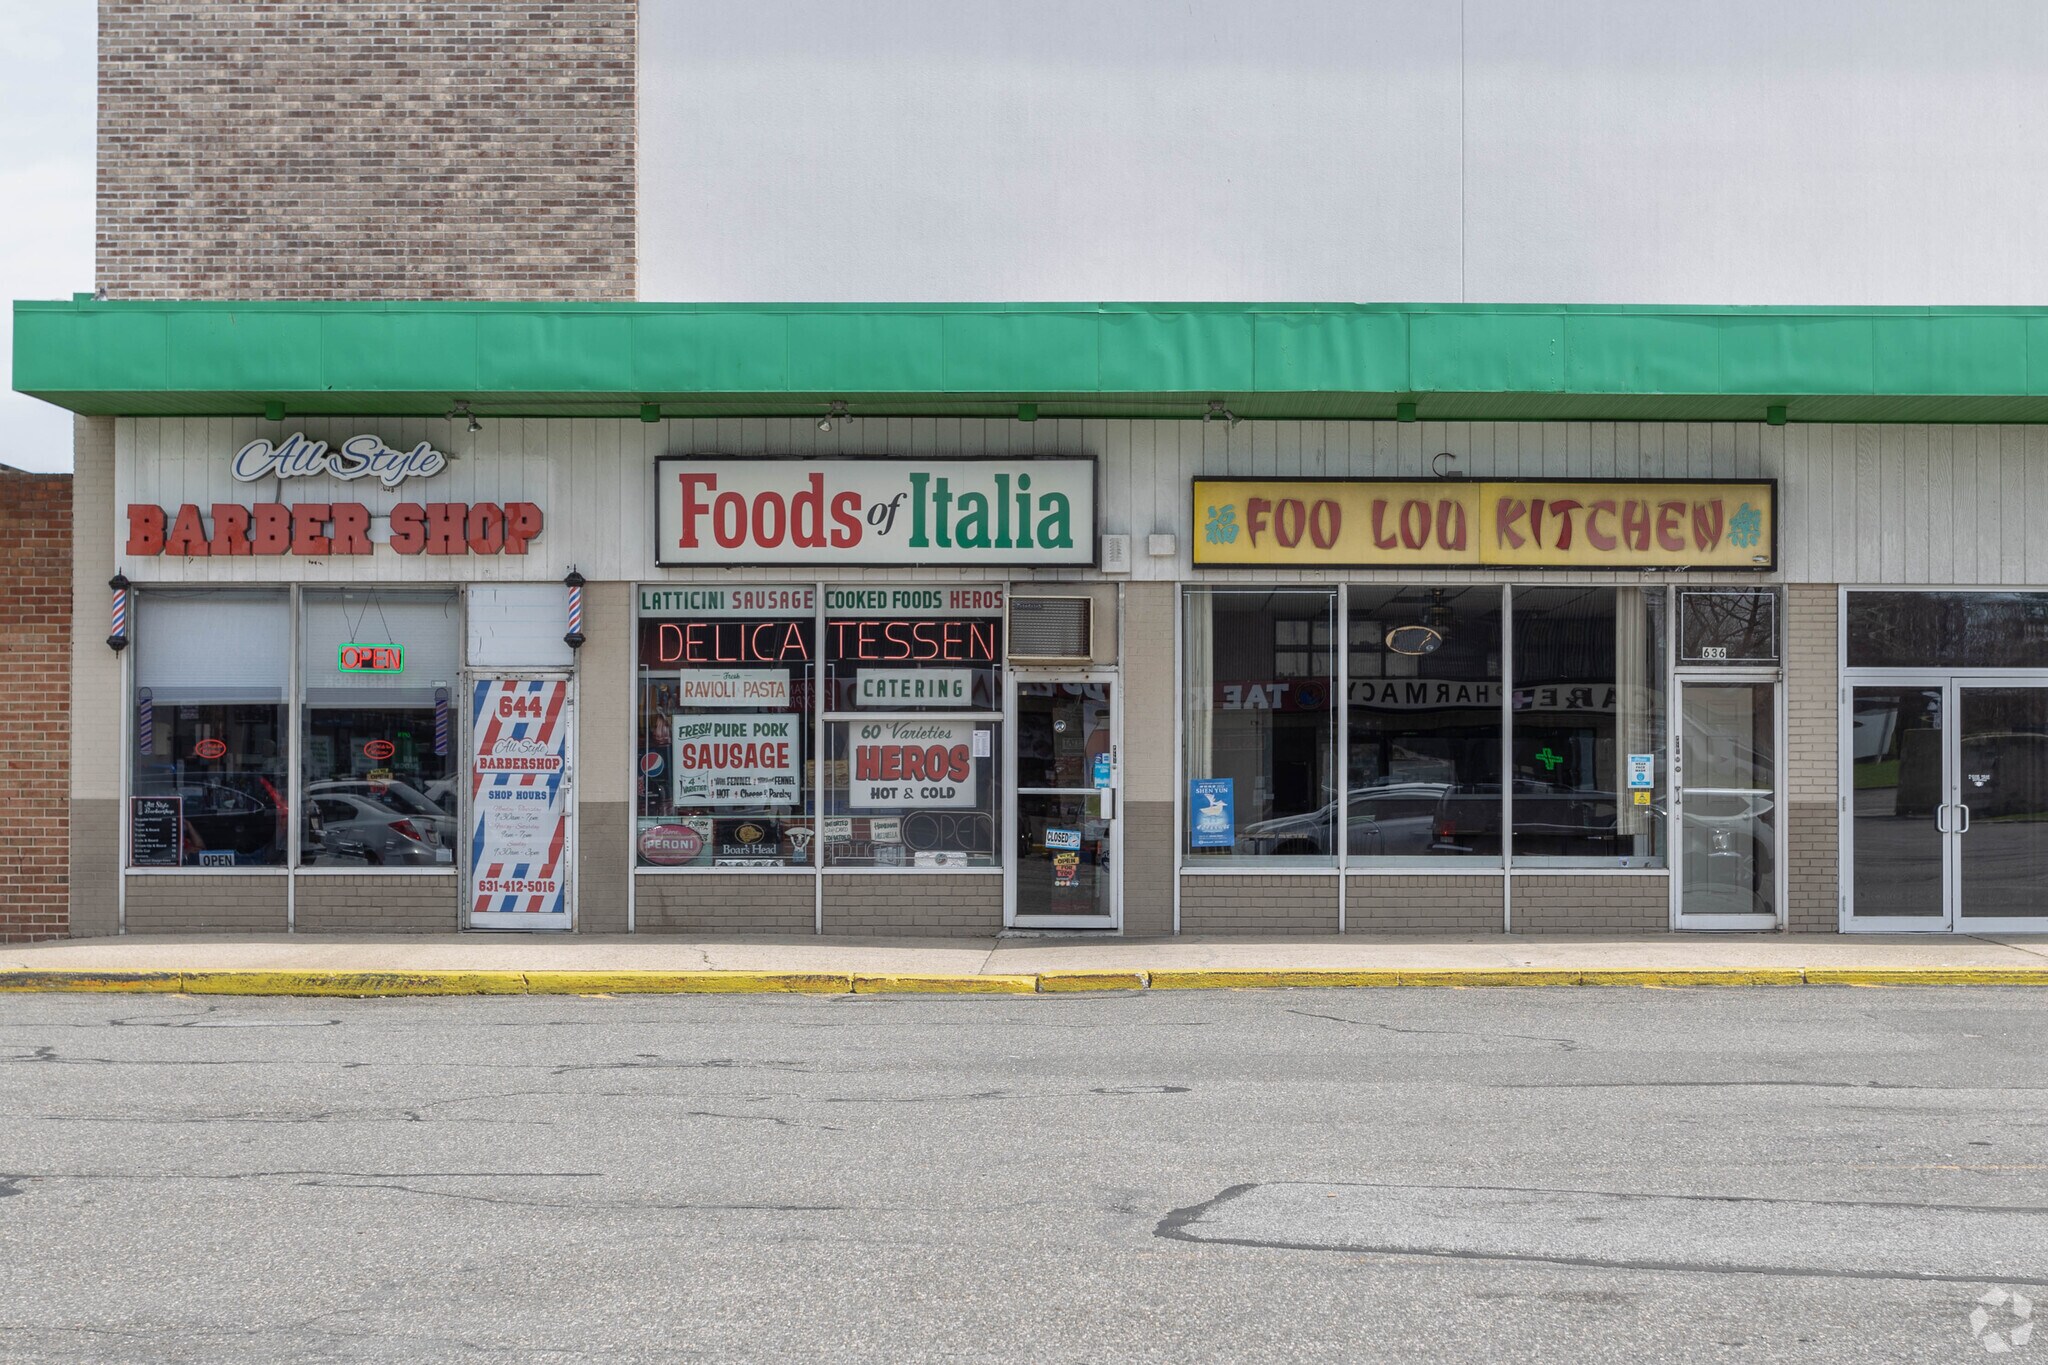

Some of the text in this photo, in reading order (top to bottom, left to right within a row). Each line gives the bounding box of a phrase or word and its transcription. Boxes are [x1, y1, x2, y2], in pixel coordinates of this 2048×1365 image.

[236, 433, 441, 484] All Style
[678, 472, 1074, 549] Foods of Italia
[126, 502, 543, 555] BARBER SHOP
[1246, 497, 1724, 552] FOO LOU KITCHEN
[641, 590, 814, 610] LATTICINI SAUSAGE
[825, 590, 1004, 609] COOKED FOODS HEROS
[341, 646, 402, 669] OPEN
[1703, 647, 1726, 658] 636
[723, 671, 741, 682] Fresh
[685, 681, 786, 698] RAVIOLI PASTA
[863, 679, 963, 698] CATERING
[499, 696, 542, 718] 644
[679, 722, 789, 738] FRESH PURE PORK
[861, 721, 952, 739] 60 Varieties
[495, 740, 545, 756] All Style
[682, 742, 790, 769] SAUSAGE
[480, 757, 560, 770] BARBERSHOP
[856, 744, 970, 783] HEROS
[727, 776, 752, 786] FENNEL
[774, 775, 796, 785] FENNEL
[488, 790, 547, 800] SHOP HOURS
[716, 788, 730, 799] HOT
[740, 788, 763, 799] Cheese
[768, 789, 792, 800] Parsley
[870, 787, 956, 799] HOT & COLD
[906, 814, 993, 850] OPEN
[1047, 831, 1069, 843] CLOSED
[647, 840, 693, 849] PERONI
[723, 844, 777, 854] Boar's Head
[203, 855, 232, 867] OPEN
[479, 880, 555, 892] 631-412-5016
